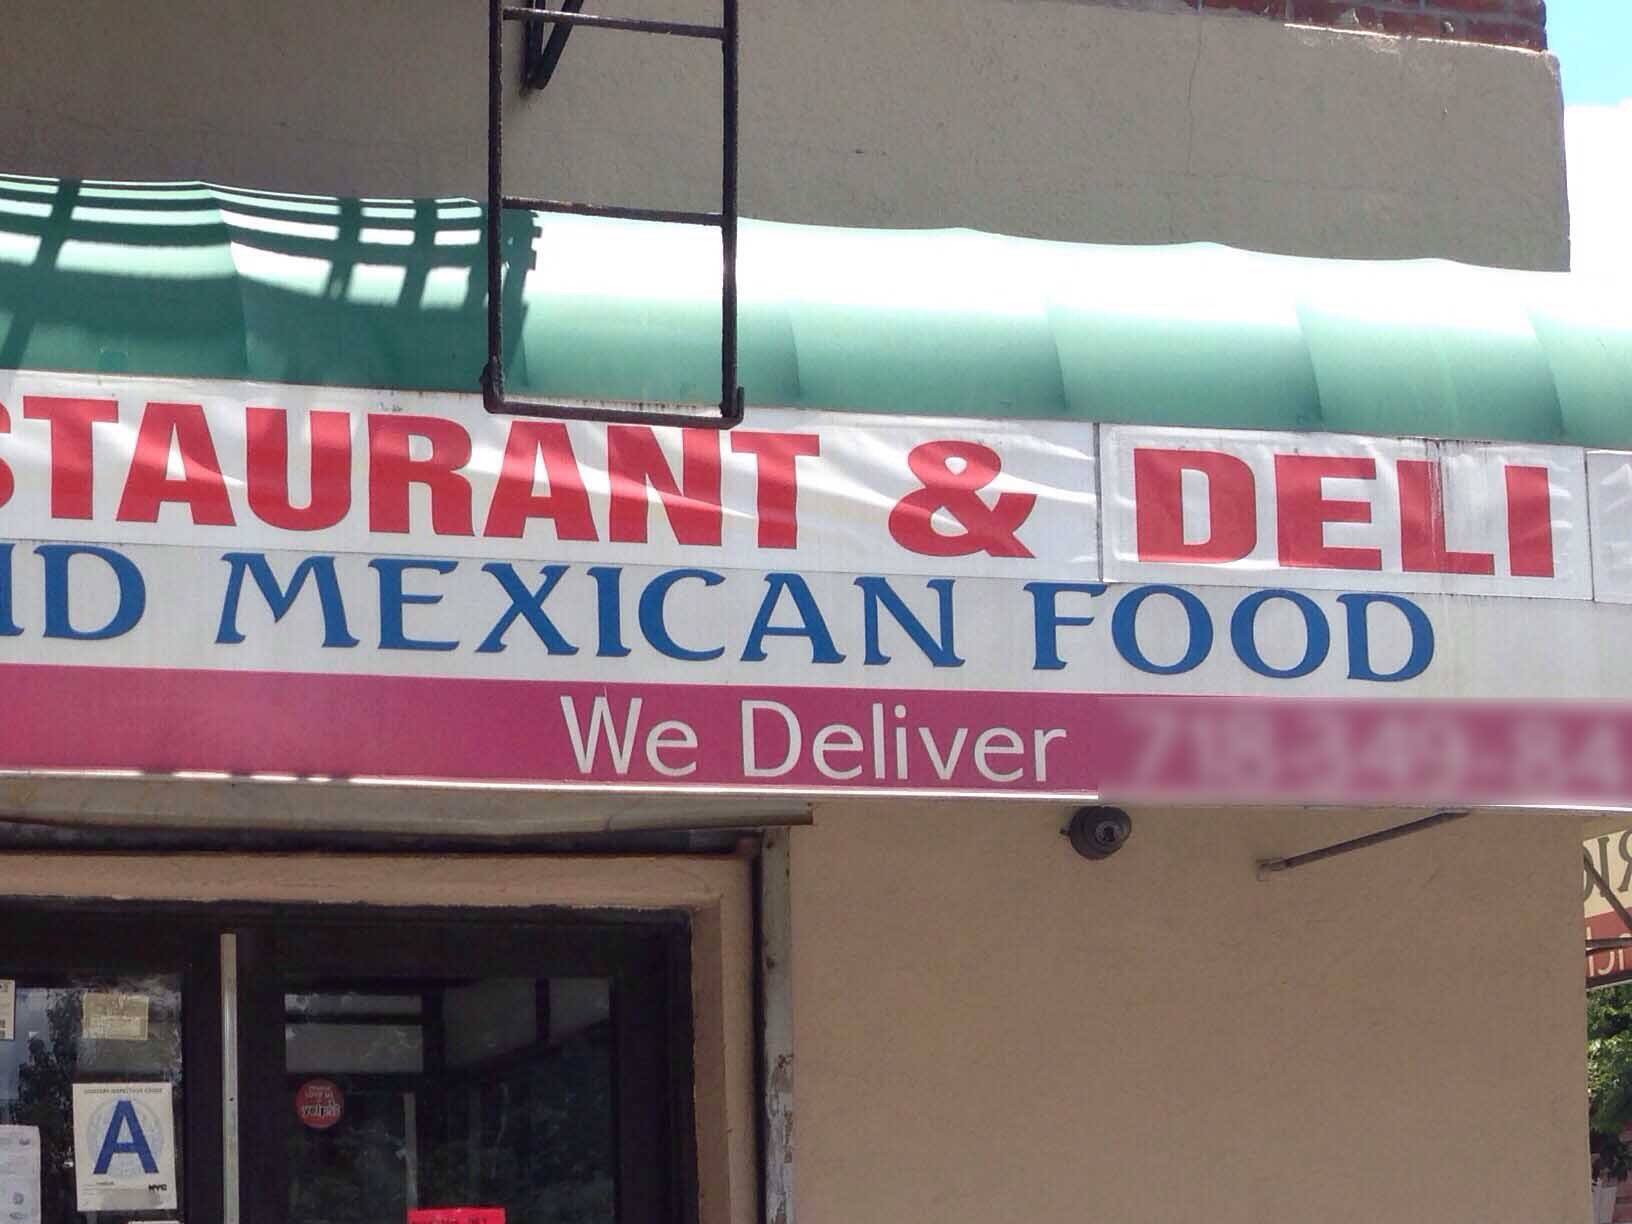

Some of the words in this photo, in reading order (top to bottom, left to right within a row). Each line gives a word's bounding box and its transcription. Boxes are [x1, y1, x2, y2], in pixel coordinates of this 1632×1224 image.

[888, 440, 1036, 558] &
[1133, 447, 1555, 578] DELI
[215, 553, 965, 668] MEXICAN
[1024, 582, 1435, 682] FOOD
[561, 695, 698, 776] We
[742, 700, 1066, 783] Deliver
[93, 1099, 159, 1174] A
